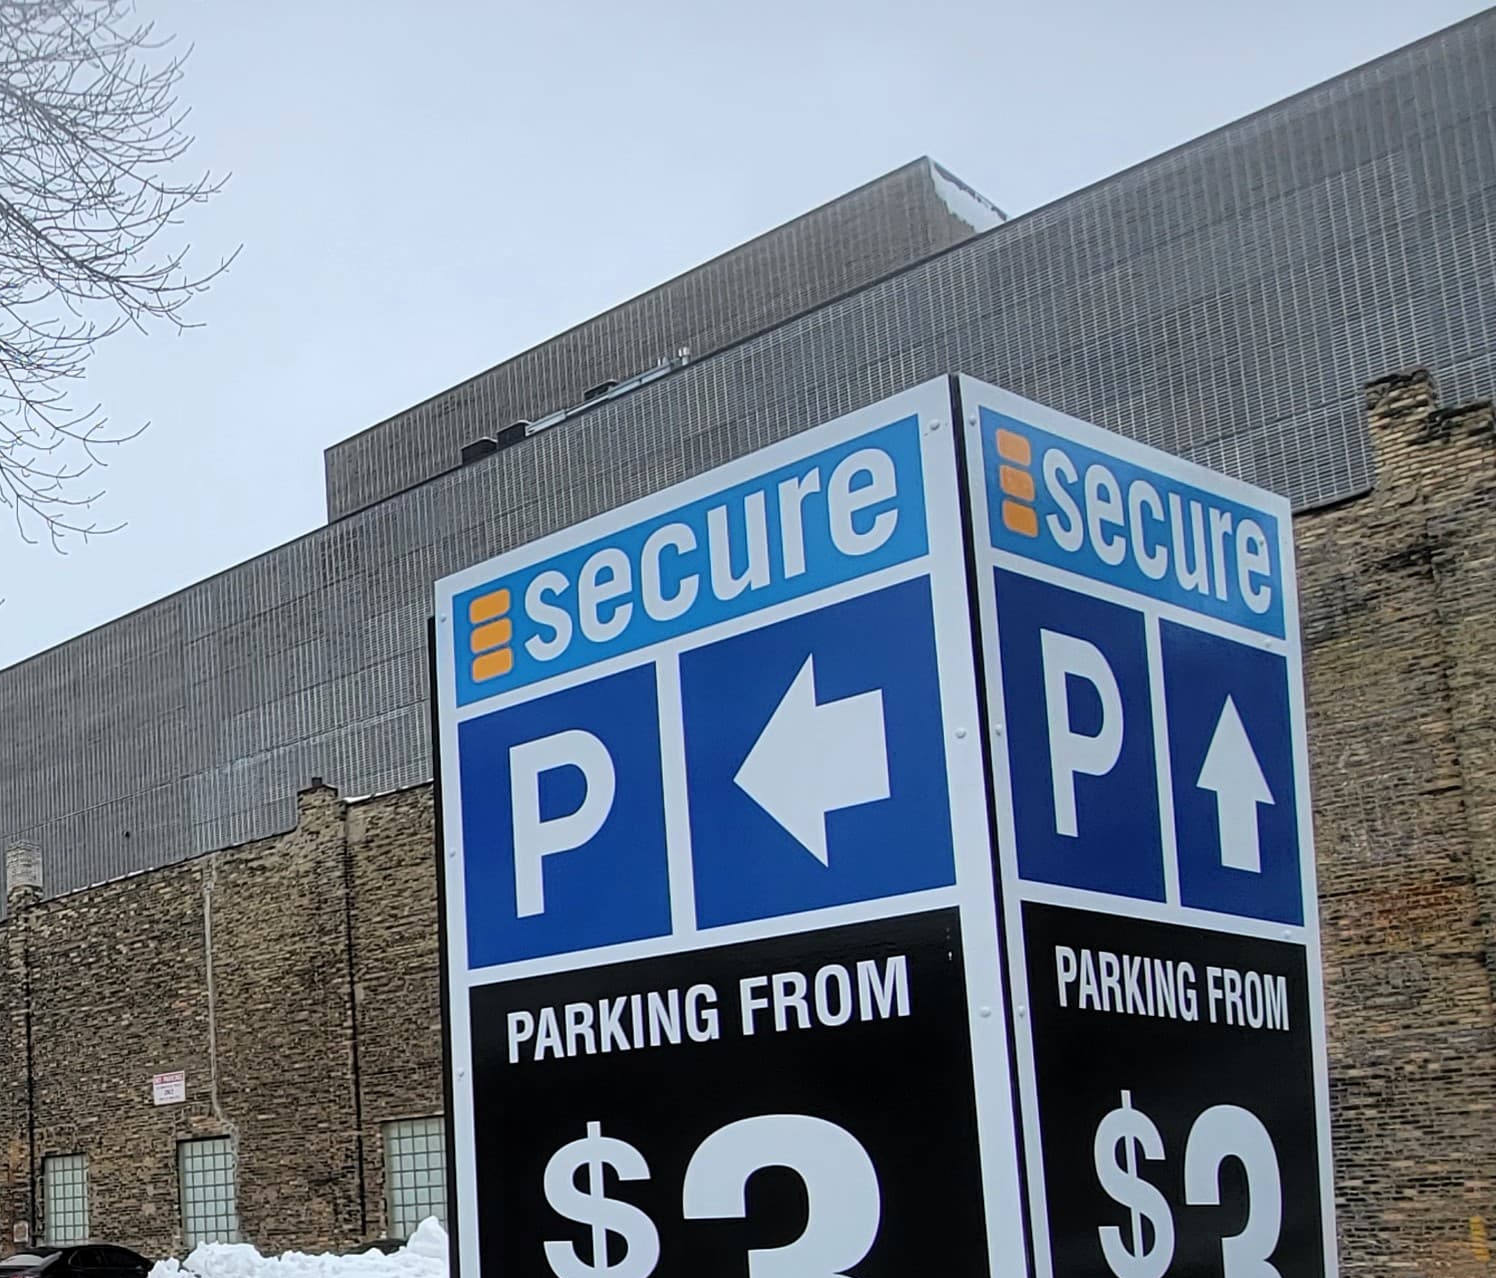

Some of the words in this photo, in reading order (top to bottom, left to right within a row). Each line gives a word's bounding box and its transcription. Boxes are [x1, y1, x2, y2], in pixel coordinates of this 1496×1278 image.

[524, 447, 899, 662] secure
[1043, 447, 1272, 614] secure
[1039, 627, 1125, 839] P
[508, 728, 617, 919] P
[506, 982, 721, 1065] PARKING
[738, 954, 911, 1037] FROM
[1054, 944, 1200, 1023] PARKING
[1205, 965, 1291, 1032] FROM
